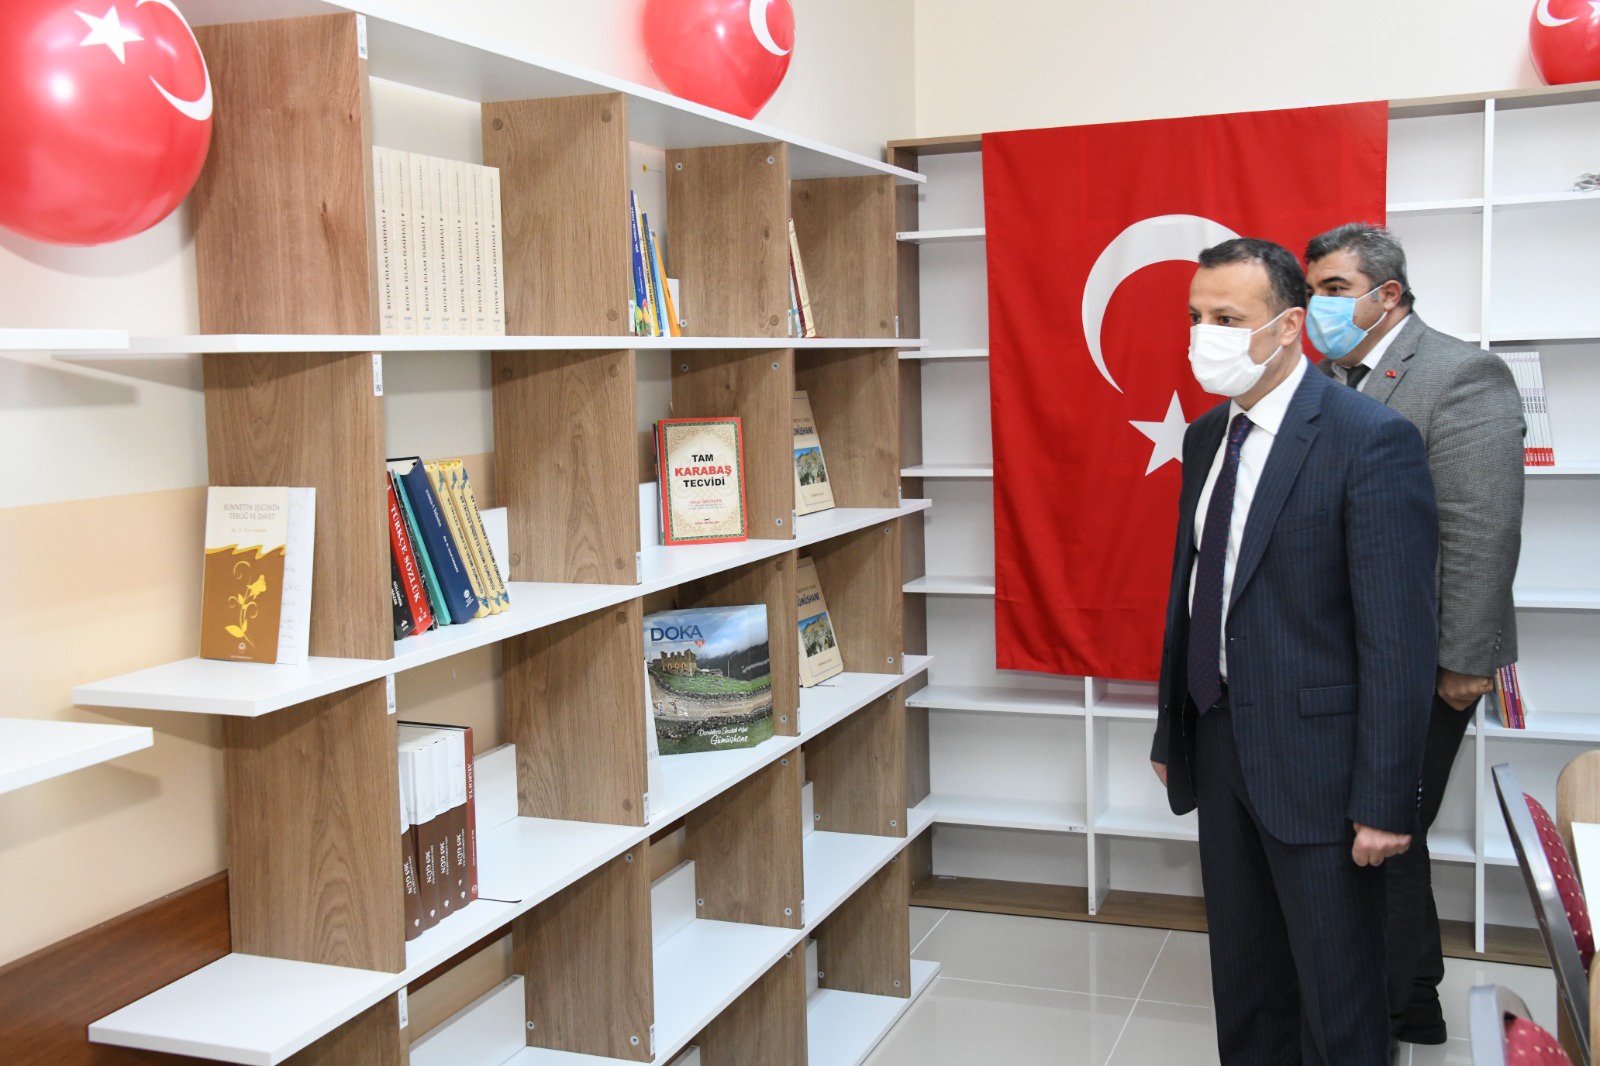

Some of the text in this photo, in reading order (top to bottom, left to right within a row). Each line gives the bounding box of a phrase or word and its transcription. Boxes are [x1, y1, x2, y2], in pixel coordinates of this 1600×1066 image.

[692, 454, 713, 462] TAM
[675, 465, 732, 477] KARABAŞ
[683, 477, 725, 487] TECVİDİ
[254, 503, 280, 512] IŞIĞINDA
[390, 503, 408, 554] TÜRKÇE
[404, 555, 421, 603] SÖZLÜK
[651, 625, 704, 641] DOKA
[711, 734, 748, 745] Gümüşhane
